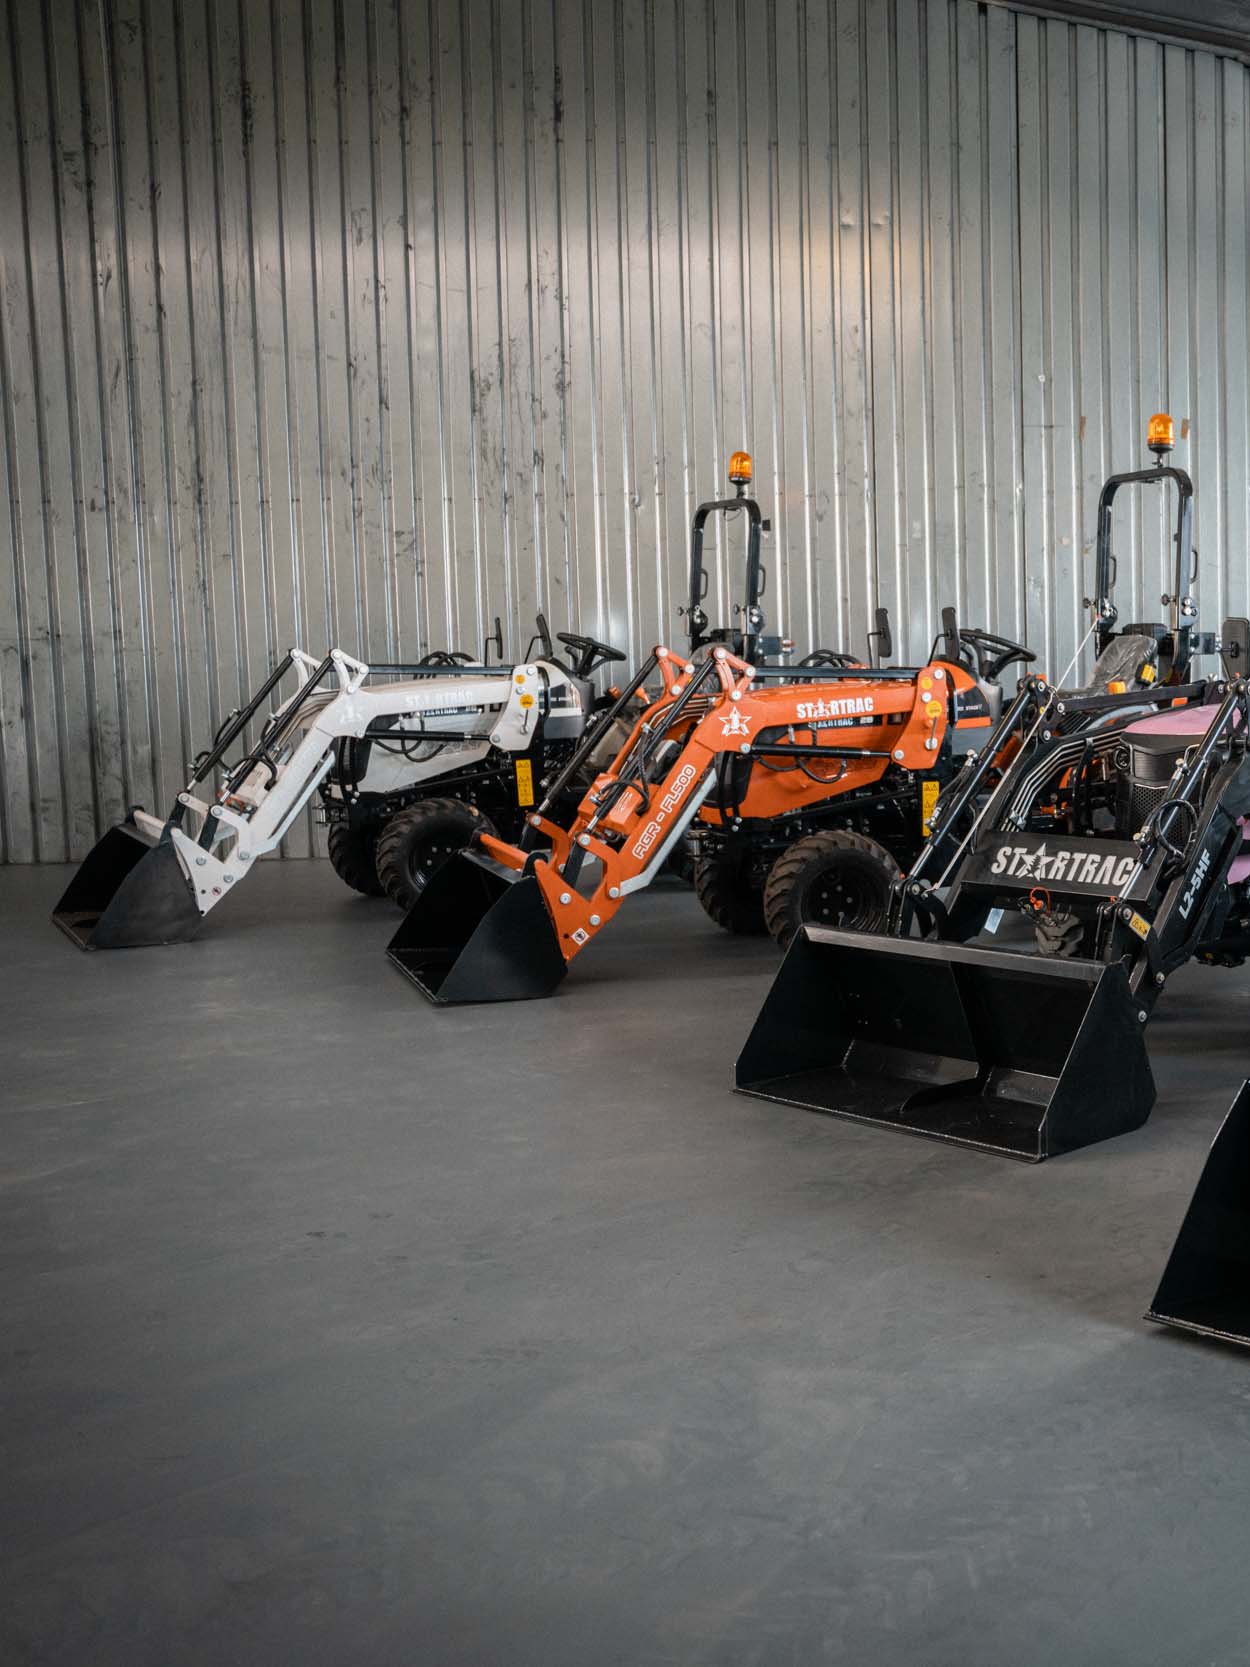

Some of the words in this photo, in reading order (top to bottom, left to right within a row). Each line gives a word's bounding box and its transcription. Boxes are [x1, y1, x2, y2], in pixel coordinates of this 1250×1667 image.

[796, 697, 875, 719] STARTRAC
[632, 820, 662, 860] AGR
[659, 763, 697, 815] FL500
[991, 842, 1136, 887] STARTRAC
